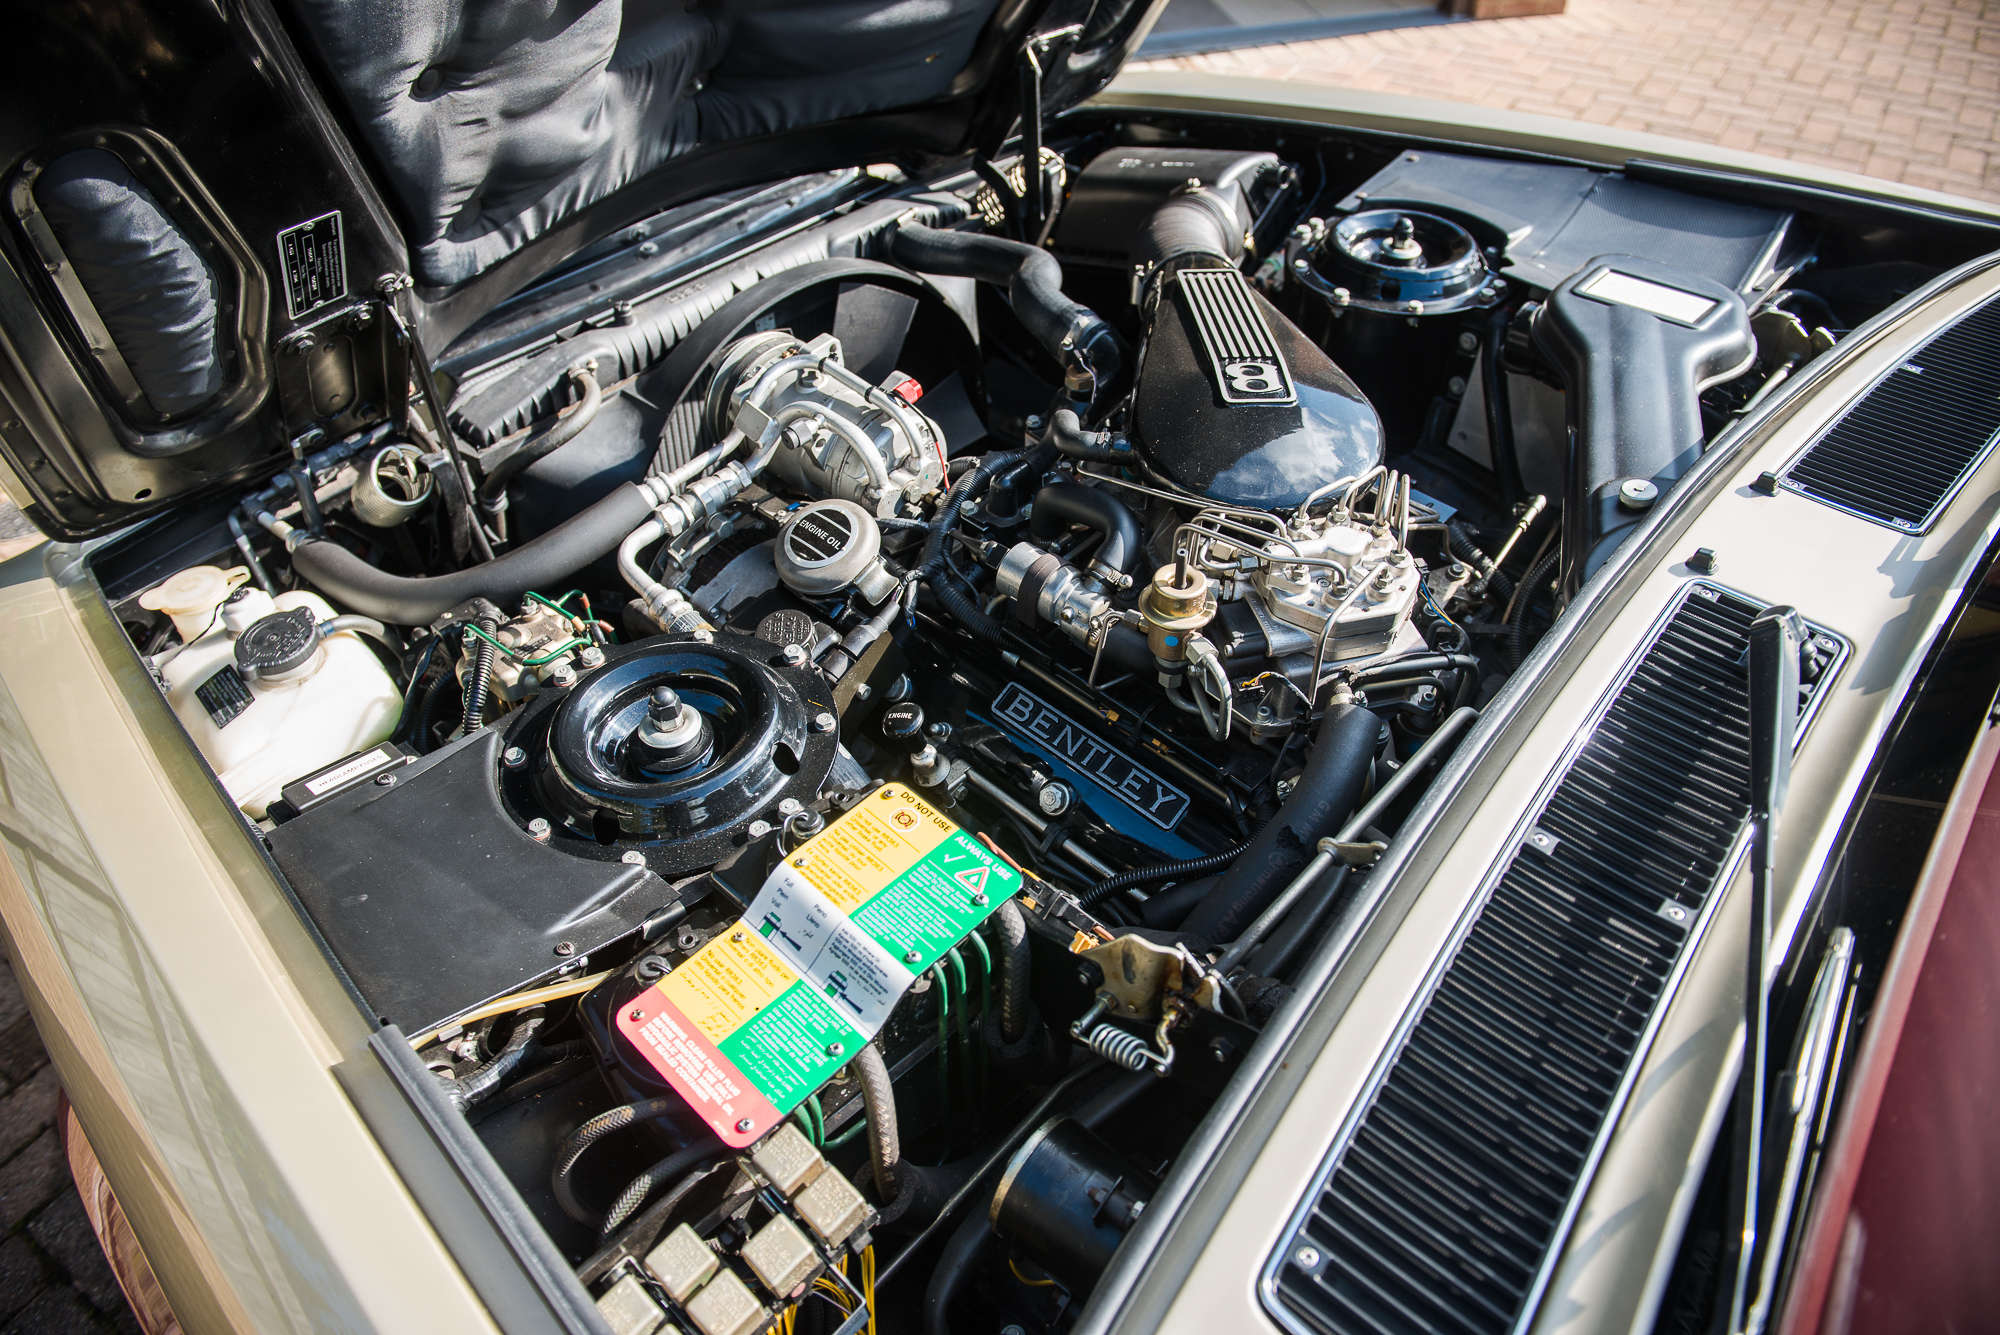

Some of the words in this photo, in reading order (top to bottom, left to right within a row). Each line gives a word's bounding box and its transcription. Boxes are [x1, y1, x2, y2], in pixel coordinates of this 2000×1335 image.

[1225, 362, 1283, 393] 8
[799, 519, 829, 540] ENGINE
[826, 536, 841, 551] OIL
[888, 712, 912, 720] ENGINE
[1004, 692, 1177, 813] BENTLEY
[900, 791, 916, 803] DO
[914, 802, 934, 818] NOT
[933, 816, 952, 832] USE
[954, 836, 993, 867] ALWAYS
[991, 863, 1012, 881] USE
